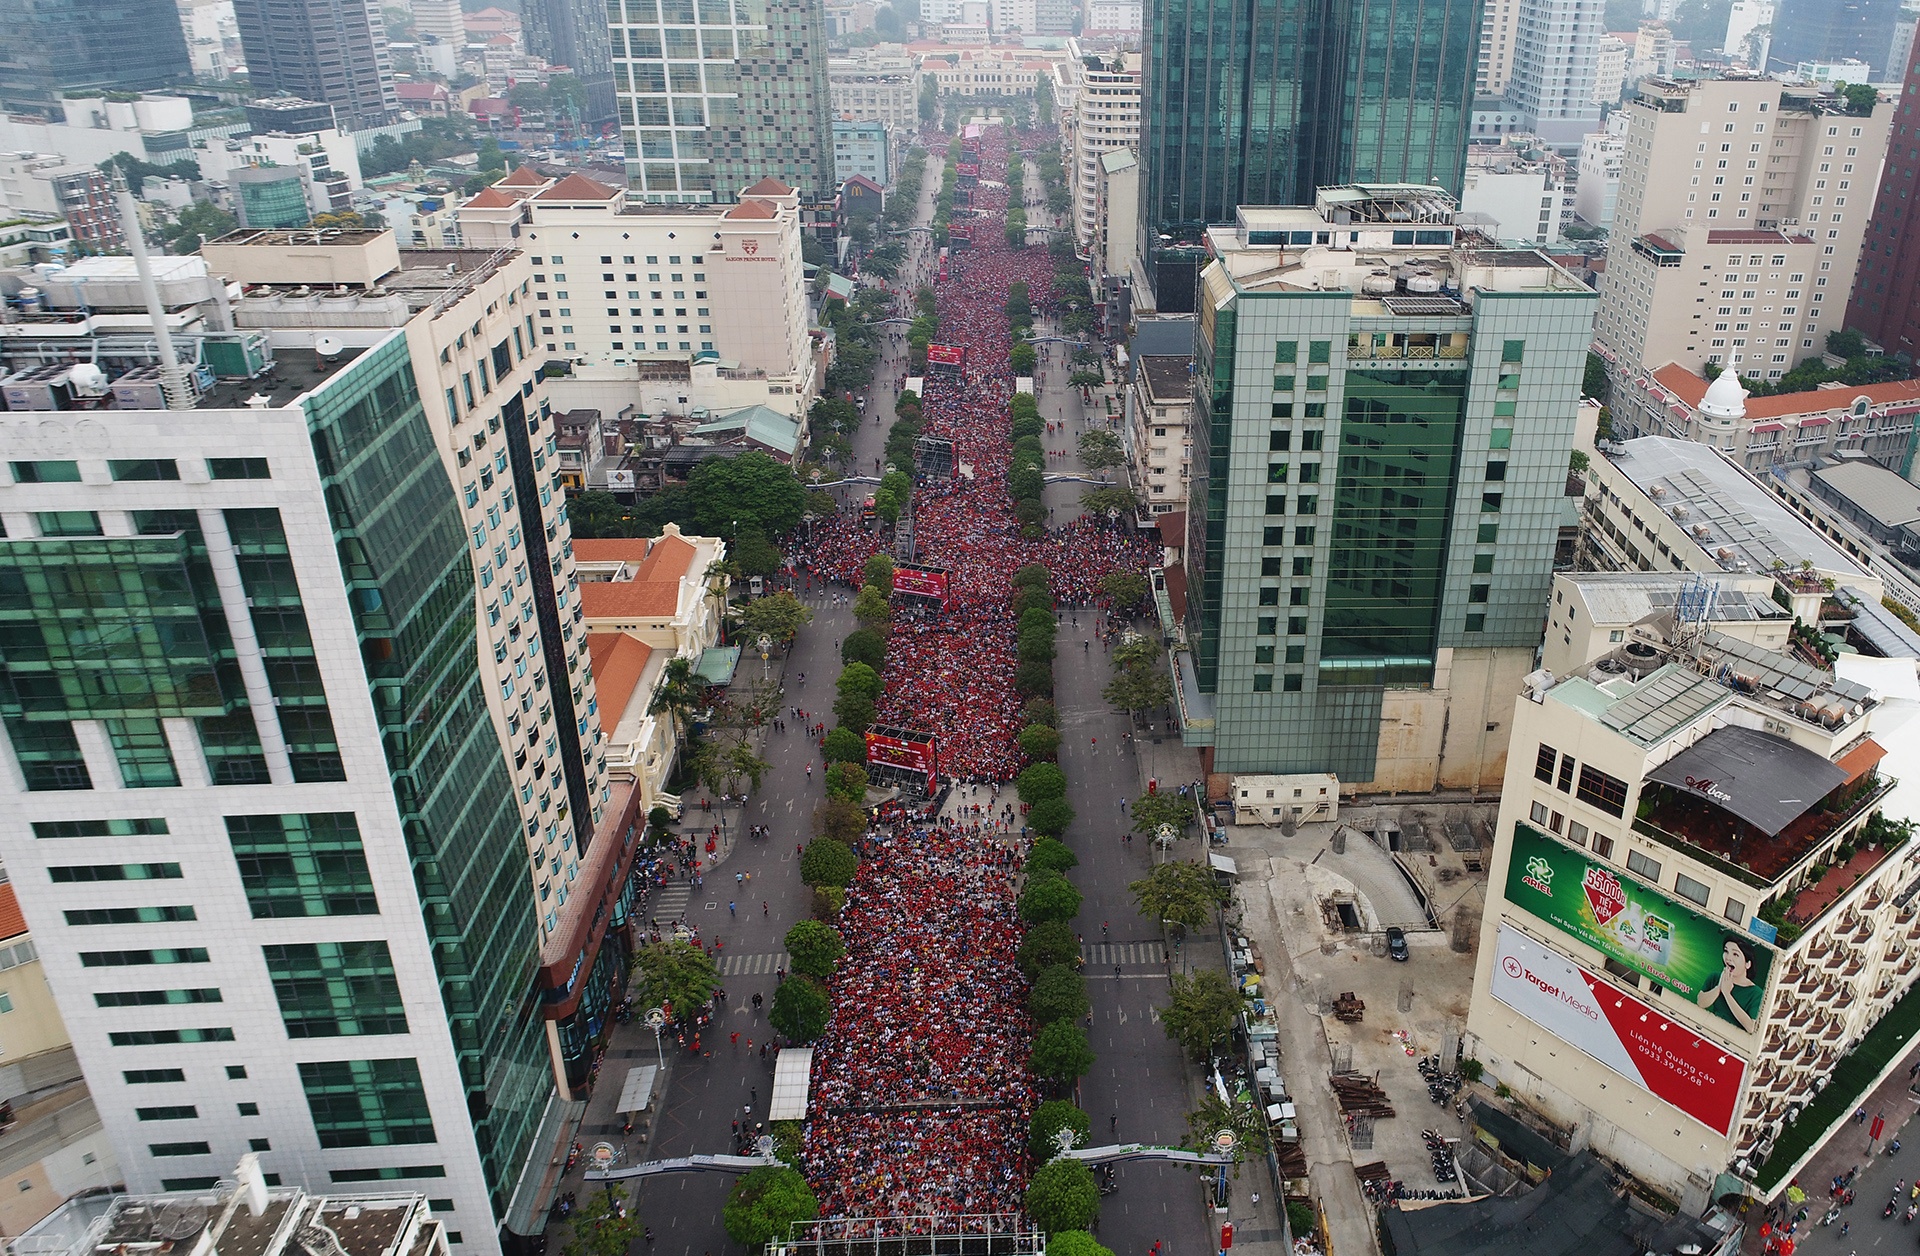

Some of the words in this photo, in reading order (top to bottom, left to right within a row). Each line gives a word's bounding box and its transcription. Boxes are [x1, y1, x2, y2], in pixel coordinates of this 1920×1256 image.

[1522, 876, 1553, 897] ARIEL
[1599, 895, 1613, 908] TIẾT
[1596, 904, 1613, 919] KIỆM
[1550, 913, 1562, 924] Loại
[1563, 921, 1578, 932] Sạch
[1601, 941, 1611, 951] Tốt
[1611, 947, 1625, 957] Hơn
[1646, 965, 1670, 983] Bước
[1642, 938, 1662, 953] ARIEL
[1524, 968, 1560, 997] Target
[1560, 991, 1599, 1020] Media
[1630, 1029, 1649, 1045] Liên
[1651, 1042, 1663, 1054] hệ
[1665, 1050, 1696, 1074] Quảng
[1698, 1071, 1716, 1084] cáo
[1638, 1045, 1702, 1086] 0933.39.67.68
